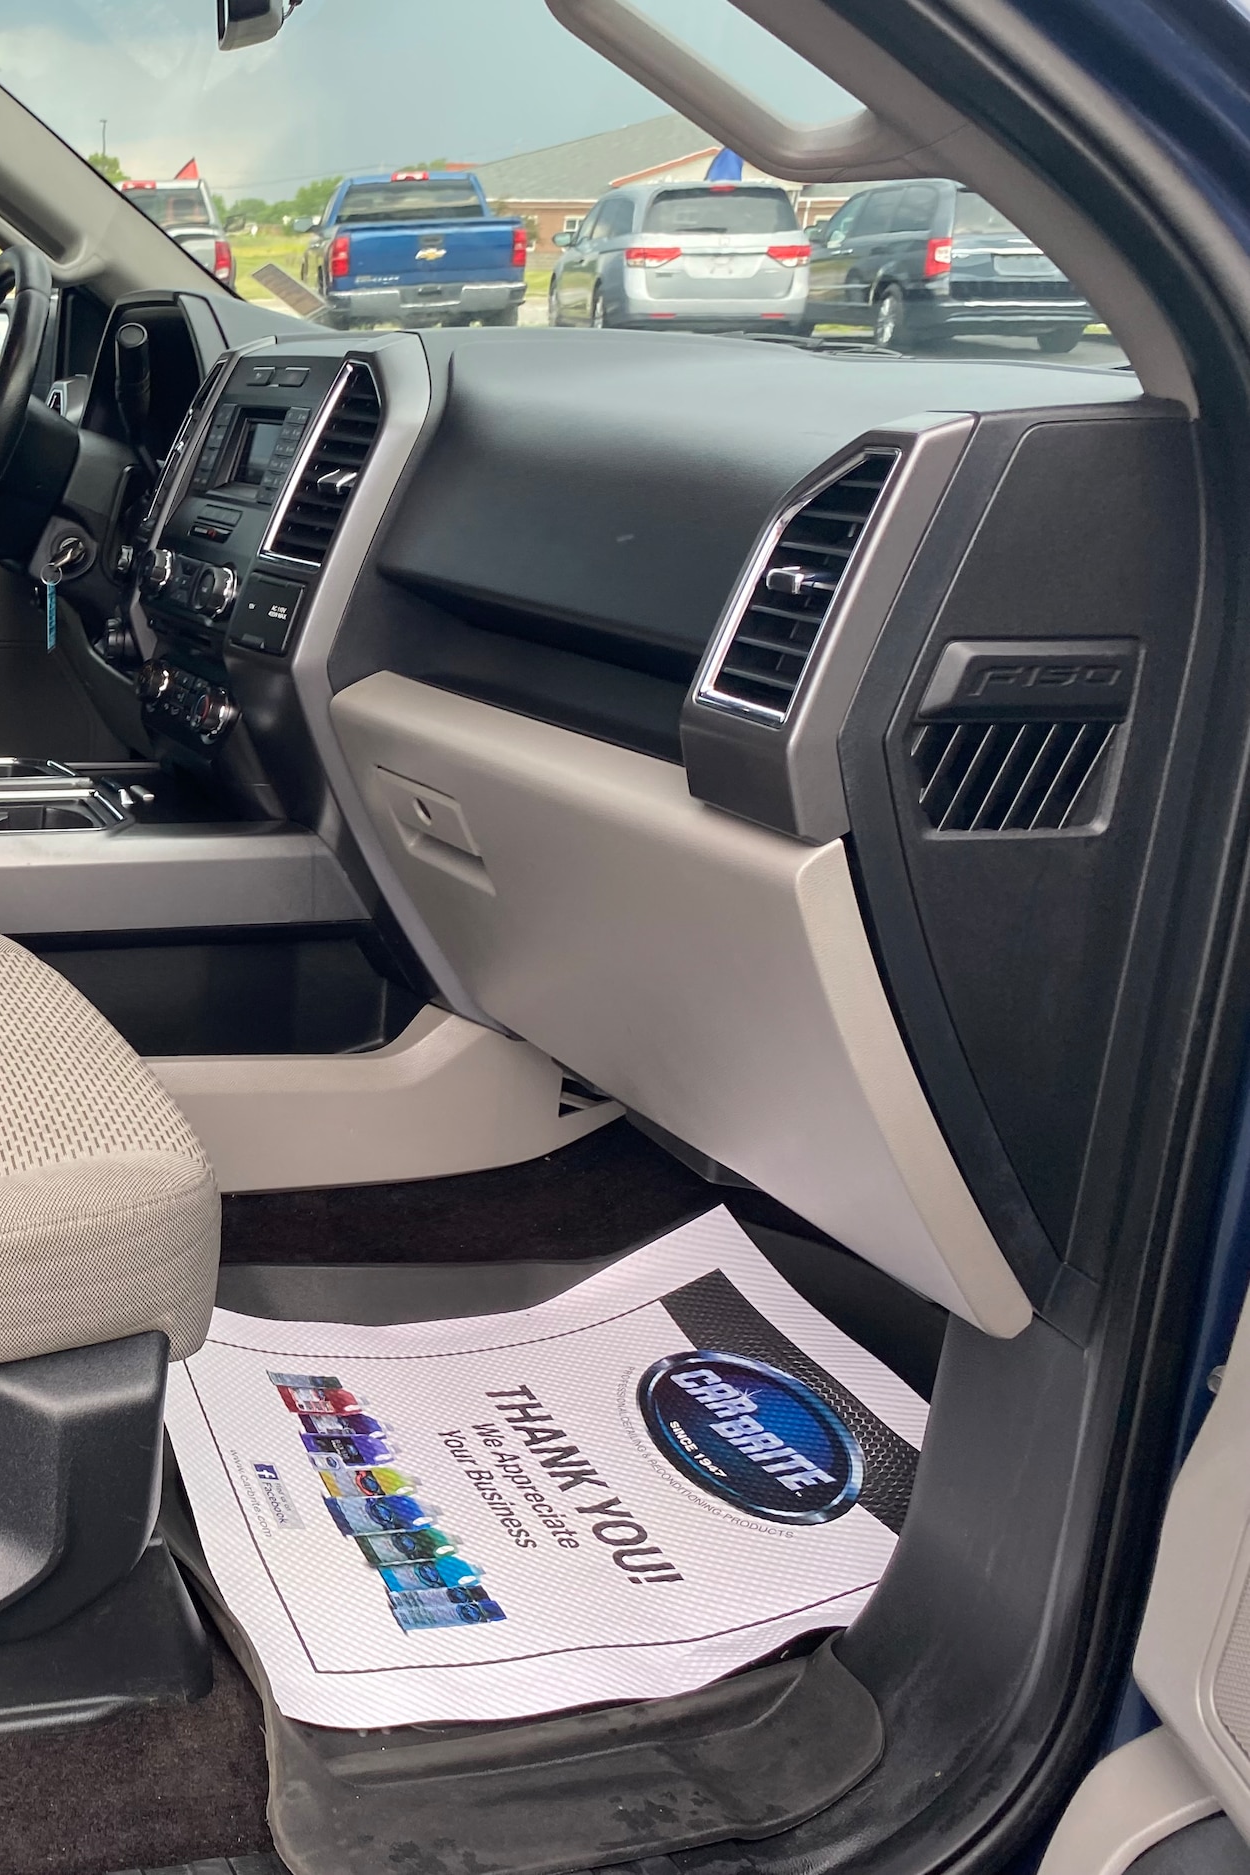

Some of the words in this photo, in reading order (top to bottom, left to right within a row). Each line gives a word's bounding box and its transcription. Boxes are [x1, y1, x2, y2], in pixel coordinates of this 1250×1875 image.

[616, 1366, 635, 1416] PROFESSIONAL
[620, 1416, 647, 1452] DETAILING
[669, 1420, 699, 1453] SINCE
[693, 1452, 728, 1479] 1947
[230, 1449, 272, 1537] www.carbrite.com
[261, 1481, 289, 1524] Facebook
[438, 1429, 478, 1467] Your
[465, 1469, 537, 1549] Business
[471, 1422, 504, 1448] We
[491, 1451, 580, 1549] Appreciate
[485, 1384, 610, 1493] THANK
[574, 1496, 685, 1585] YOU!
[648, 1459, 722, 1516] RECONDITIONING
[723, 1513, 794, 1538] PRODUCTS
